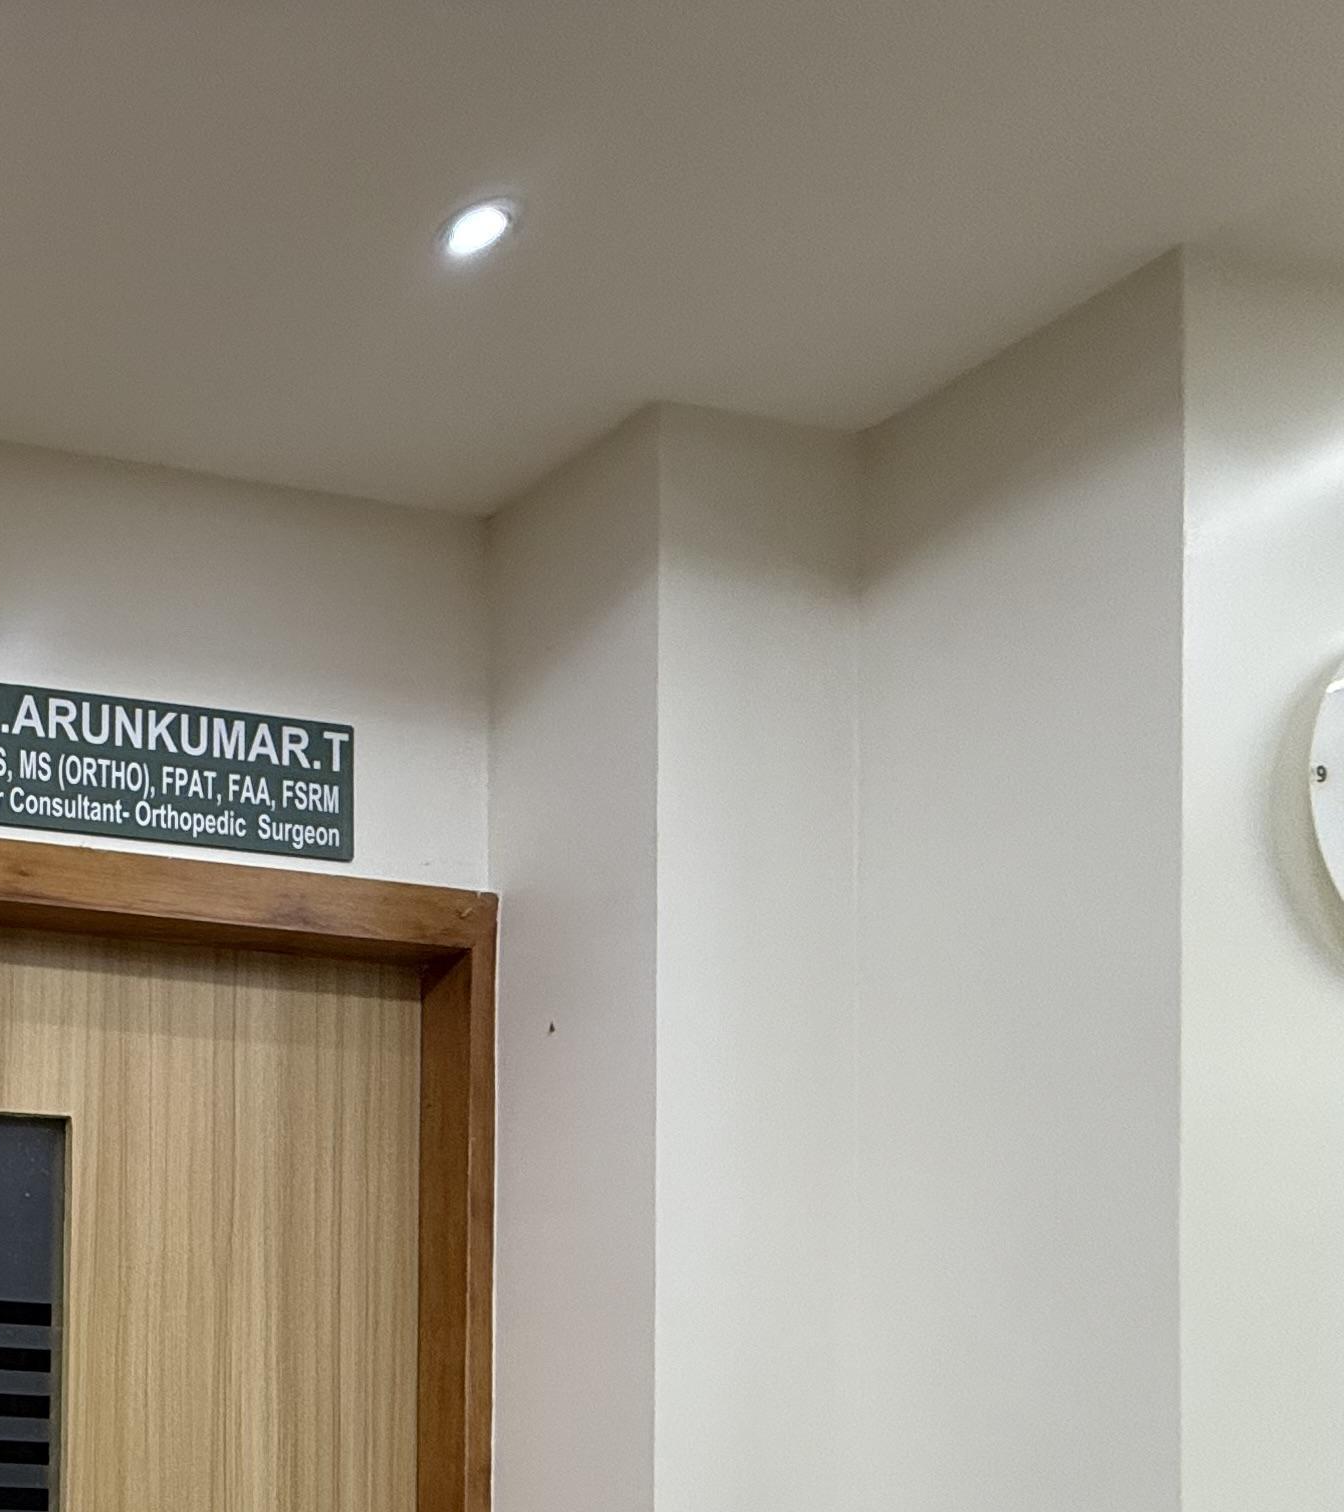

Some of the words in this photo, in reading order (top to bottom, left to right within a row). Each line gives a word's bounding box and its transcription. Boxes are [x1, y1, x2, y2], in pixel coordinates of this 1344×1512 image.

[19, 750, 52, 781] MS
[58, 753, 155, 799] (ORTHO),
[162, 767, 222, 806] FPAT,
[228, 774, 276, 810] FAA,
[282, 780, 340, 814] FSRM
[1316, 765, 1327, 783] 9
[9, 788, 129, 824] Consultant-
[135, 802, 246, 839] Orthopedic
[258, 815, 340, 850] Surgeon
